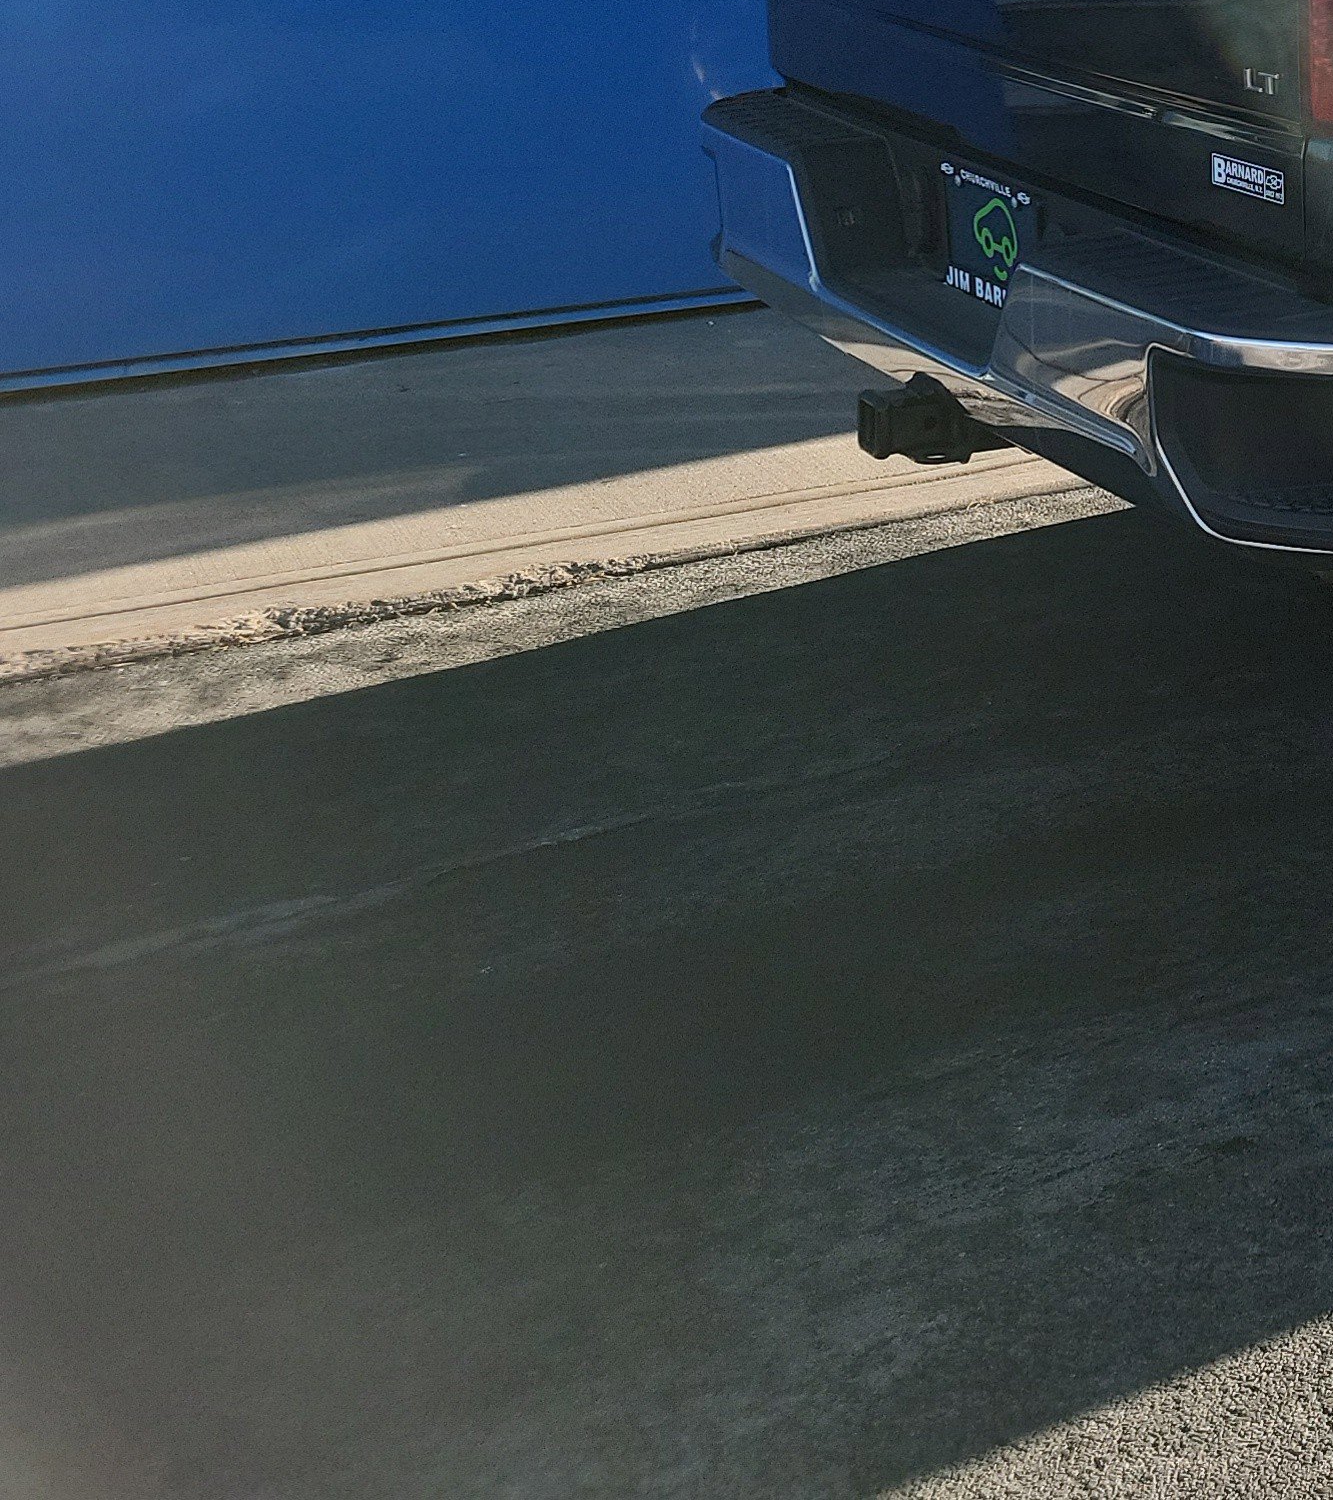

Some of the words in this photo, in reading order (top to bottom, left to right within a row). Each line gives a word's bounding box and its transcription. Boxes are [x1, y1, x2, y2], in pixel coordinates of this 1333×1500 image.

[1243, 68, 1280, 95] LT
[1213, 156, 1264, 185] BARNARD
[946, 265, 970, 293] JIM
